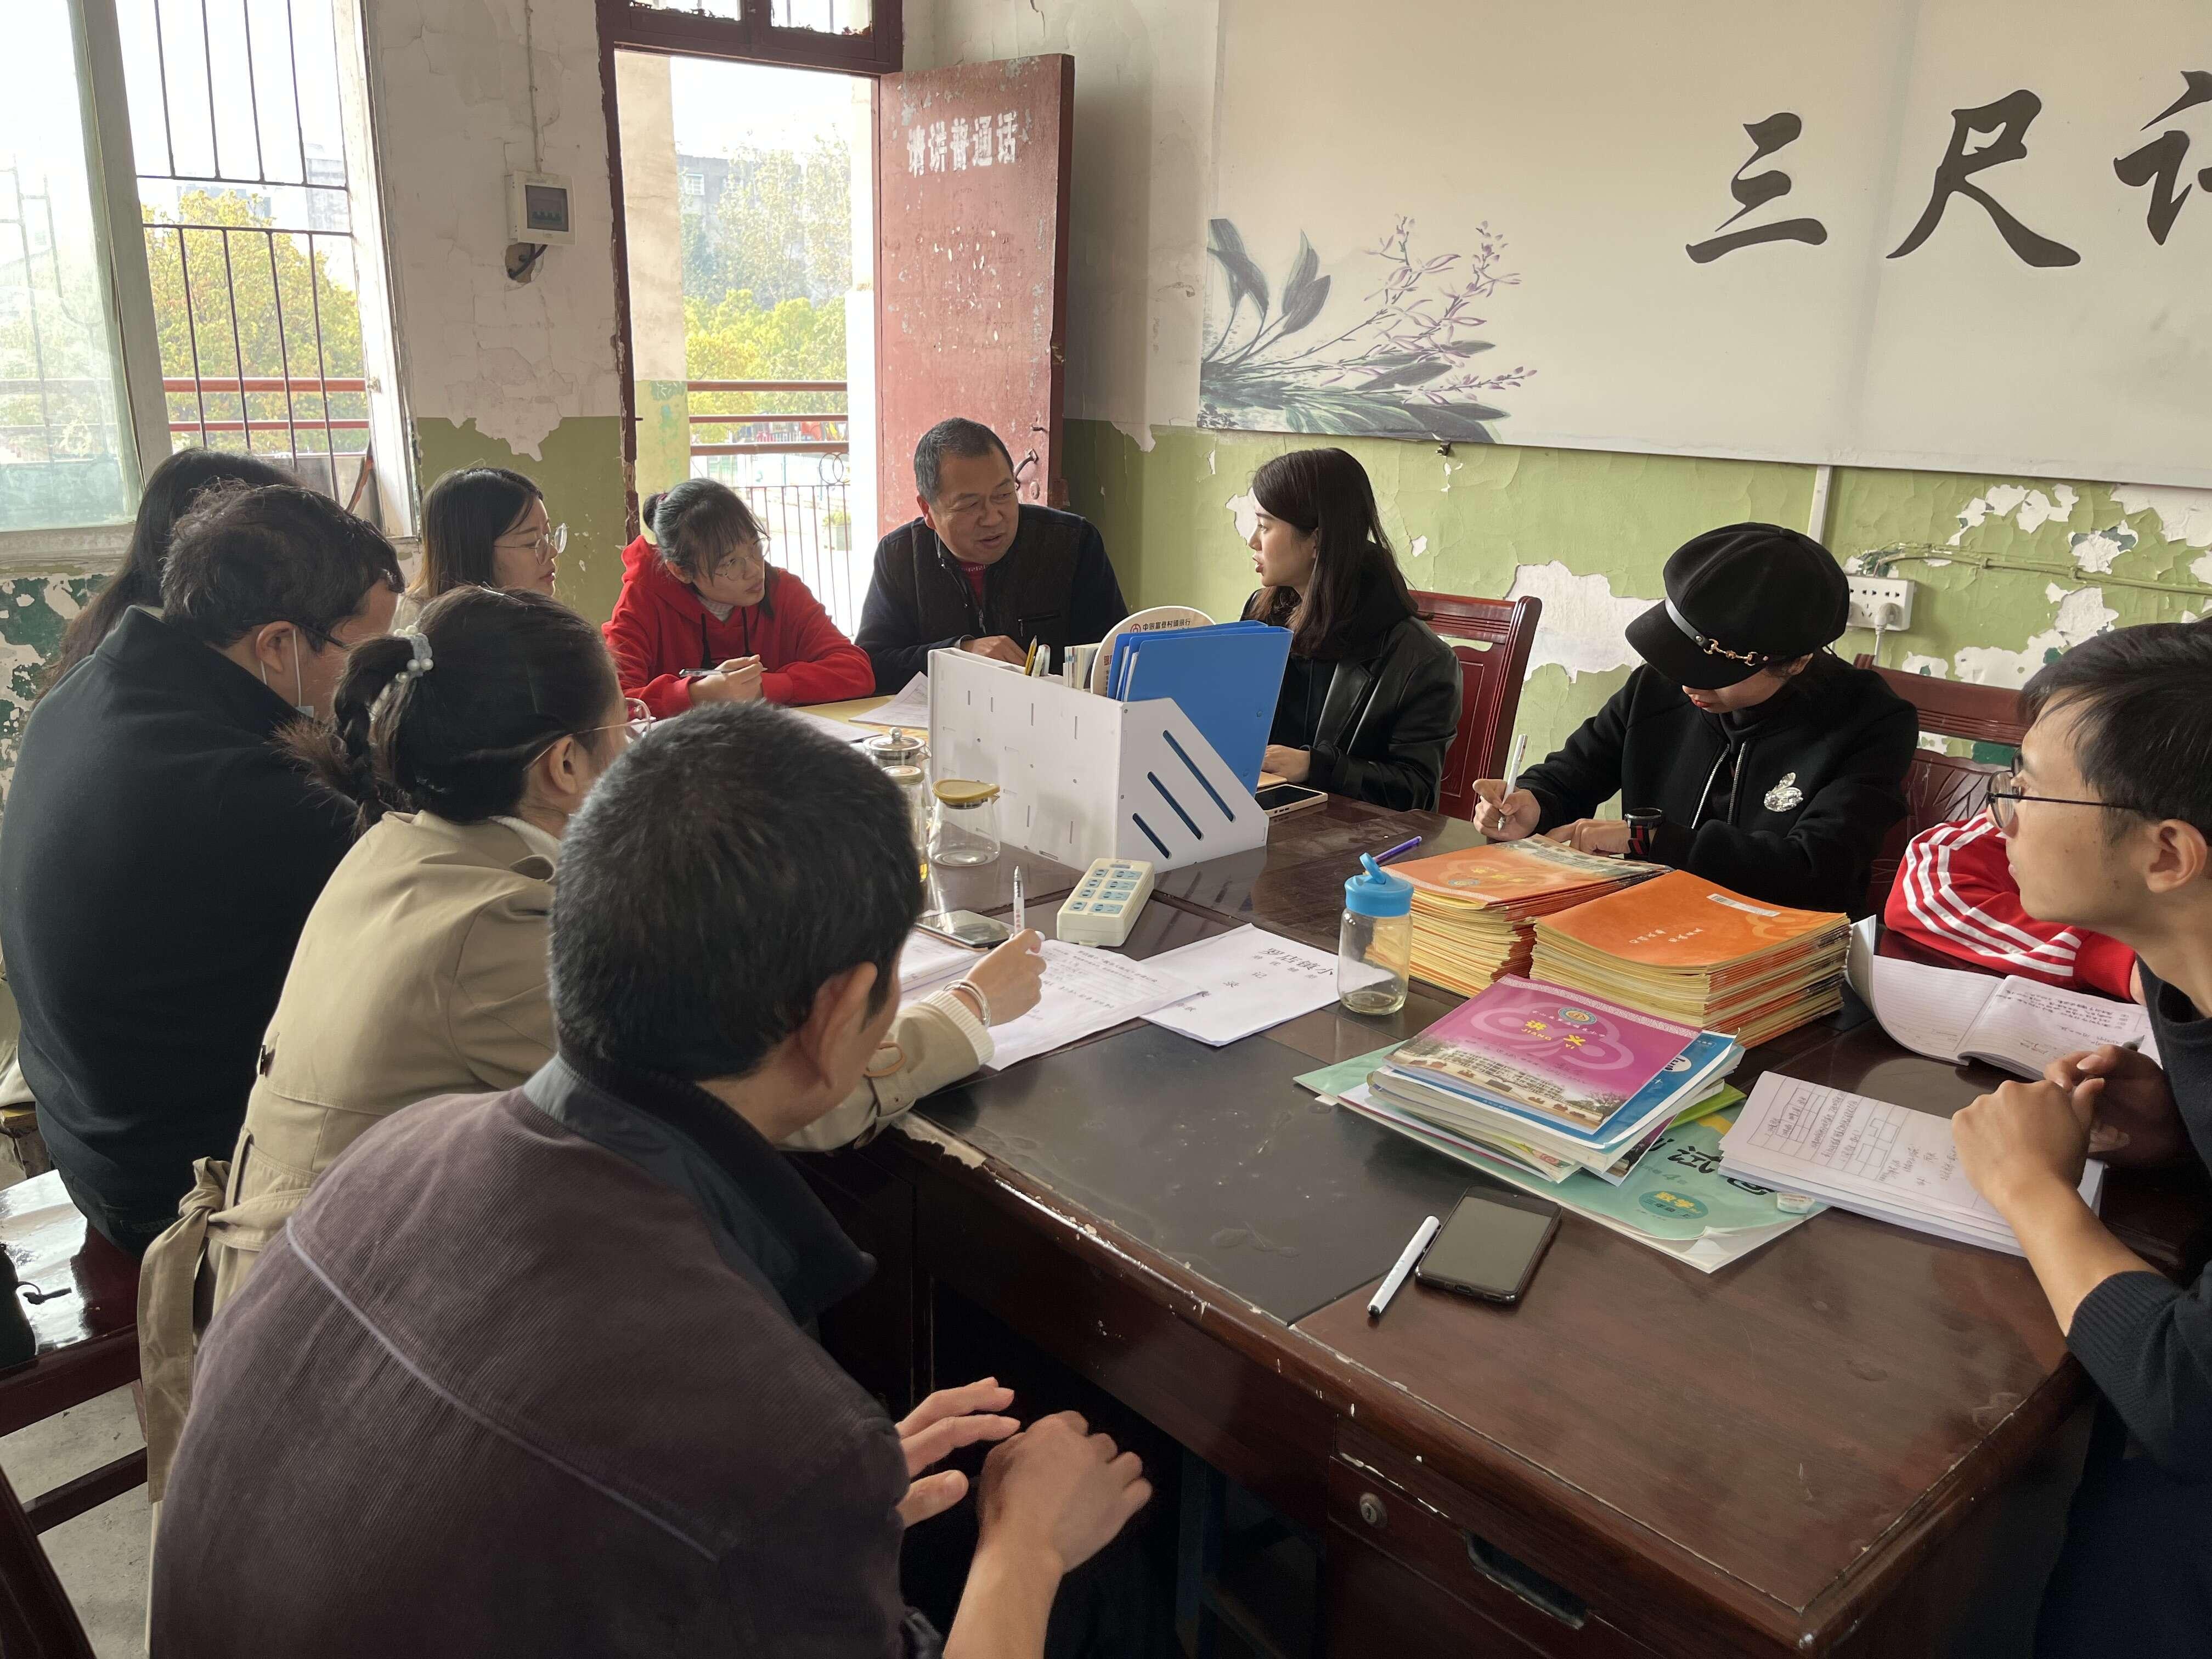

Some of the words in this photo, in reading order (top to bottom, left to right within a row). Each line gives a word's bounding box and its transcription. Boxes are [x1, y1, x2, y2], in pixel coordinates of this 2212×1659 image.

[906, 110, 1018, 178] 请讲普通话
